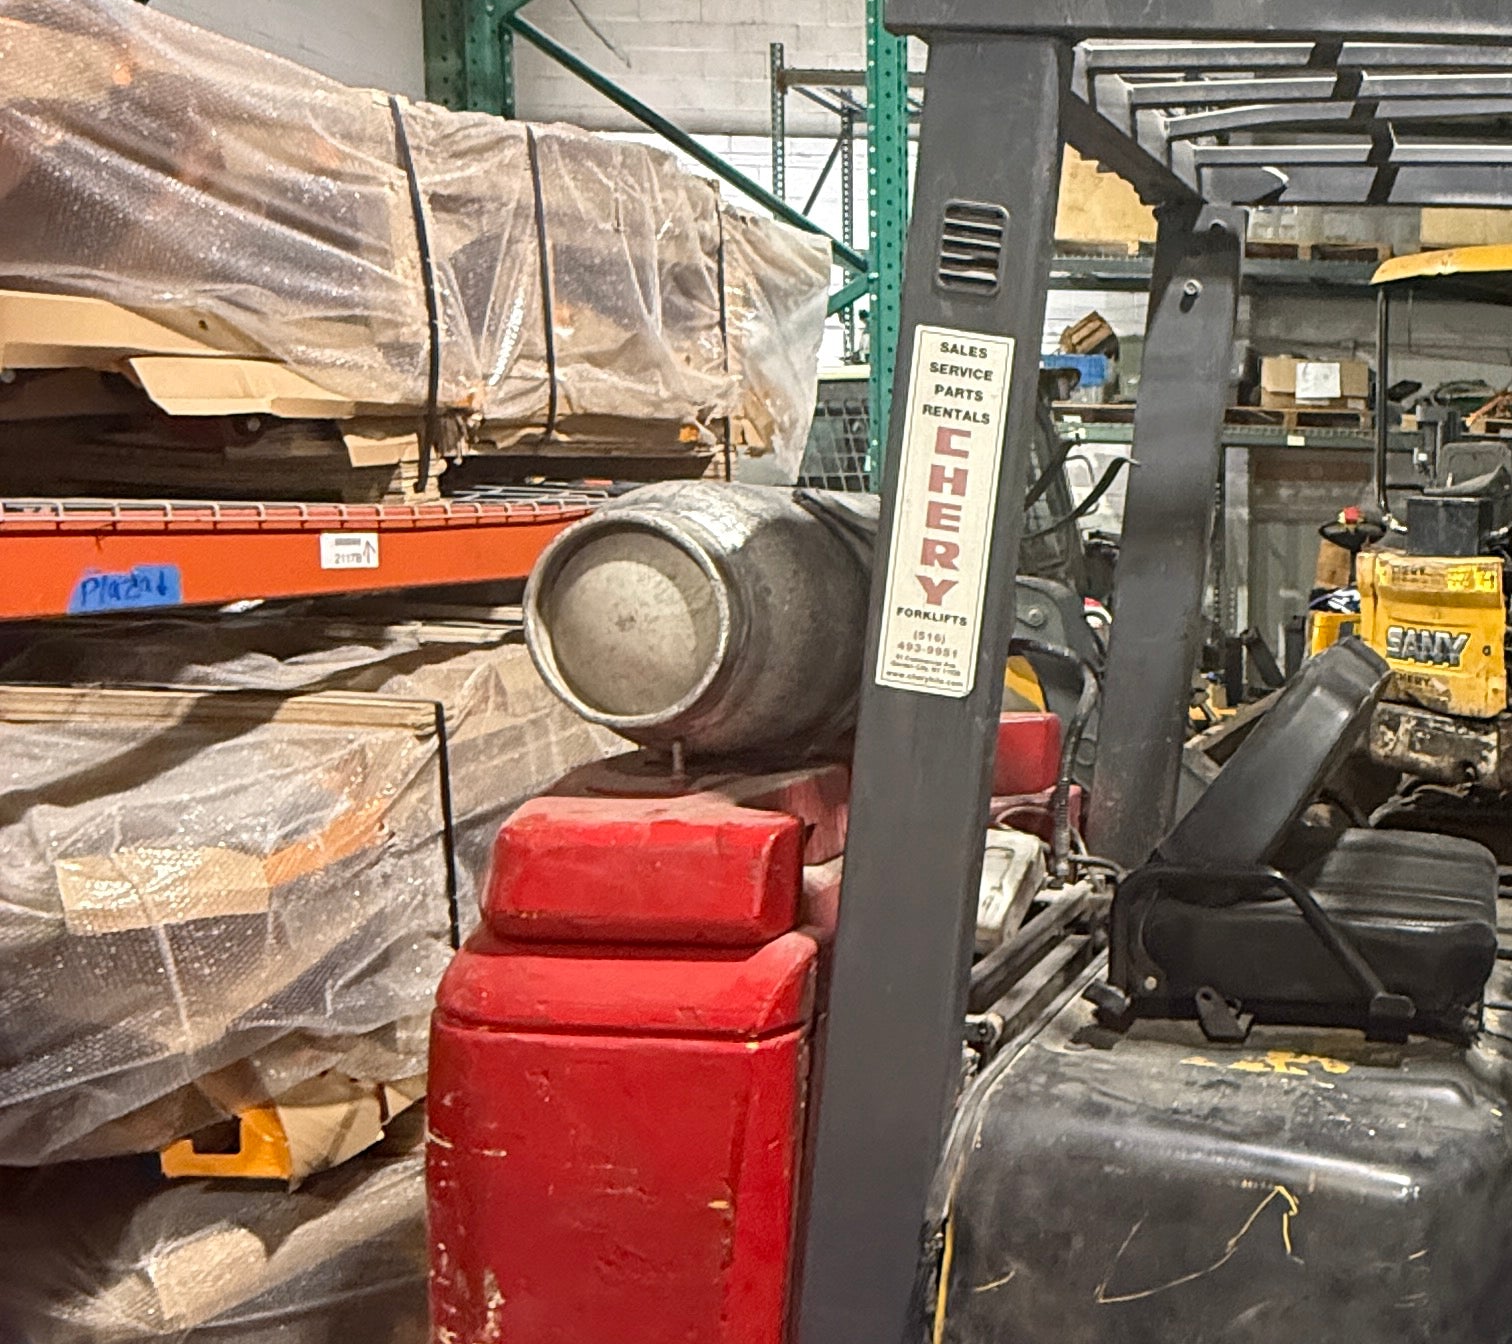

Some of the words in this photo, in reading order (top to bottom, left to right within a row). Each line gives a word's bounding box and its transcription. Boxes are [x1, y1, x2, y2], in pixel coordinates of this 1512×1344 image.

[940, 342, 988, 359] SALES
[929, 362, 994, 381] SERVICE
[934, 384, 984, 402] PARTS
[922, 404, 990, 425] RENTALS
[915, 425, 972, 607] CHERY
[896, 607, 968, 627] FORKLIFTS
[1386, 625, 1471, 668] SANY
